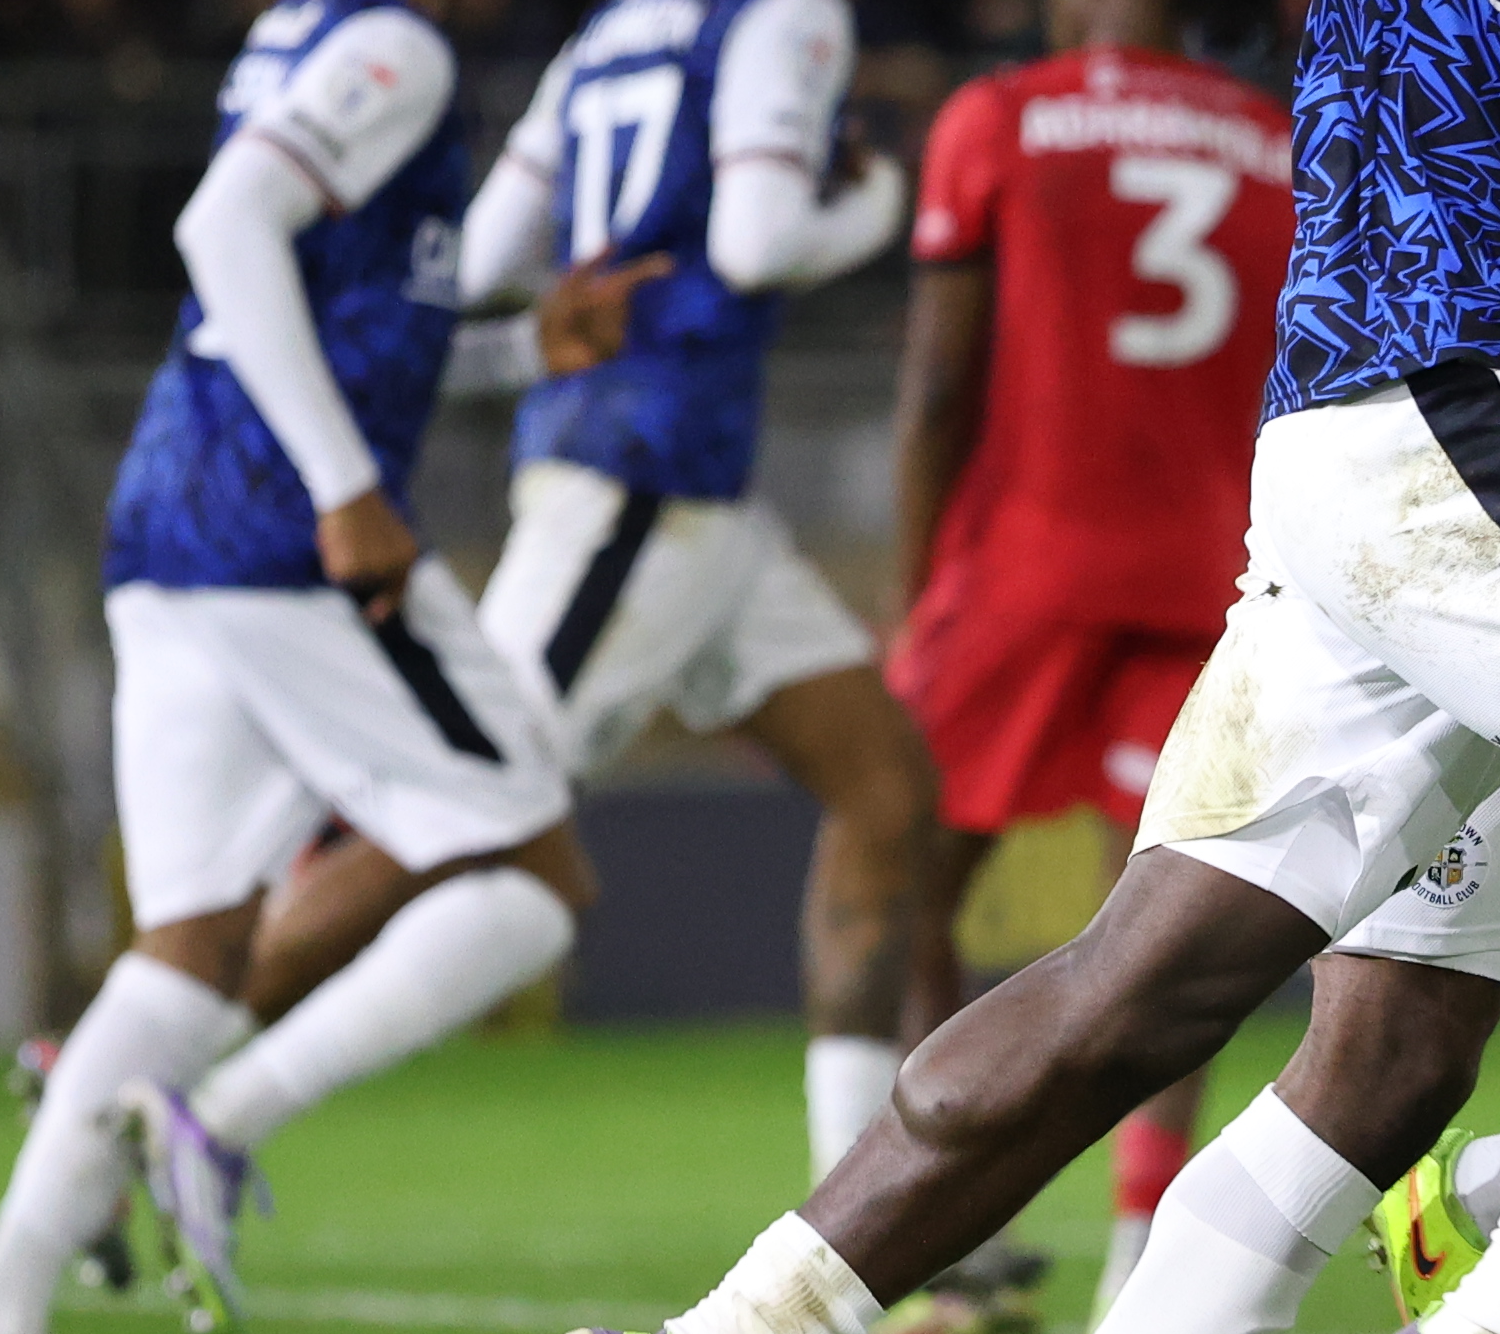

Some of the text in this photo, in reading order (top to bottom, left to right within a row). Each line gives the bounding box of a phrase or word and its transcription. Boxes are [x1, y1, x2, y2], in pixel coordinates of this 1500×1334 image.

[568, 63, 687, 266] 17
[1106, 154, 1241, 367] 3
[1411, 880, 1480, 905] OOTBALL CLUB
